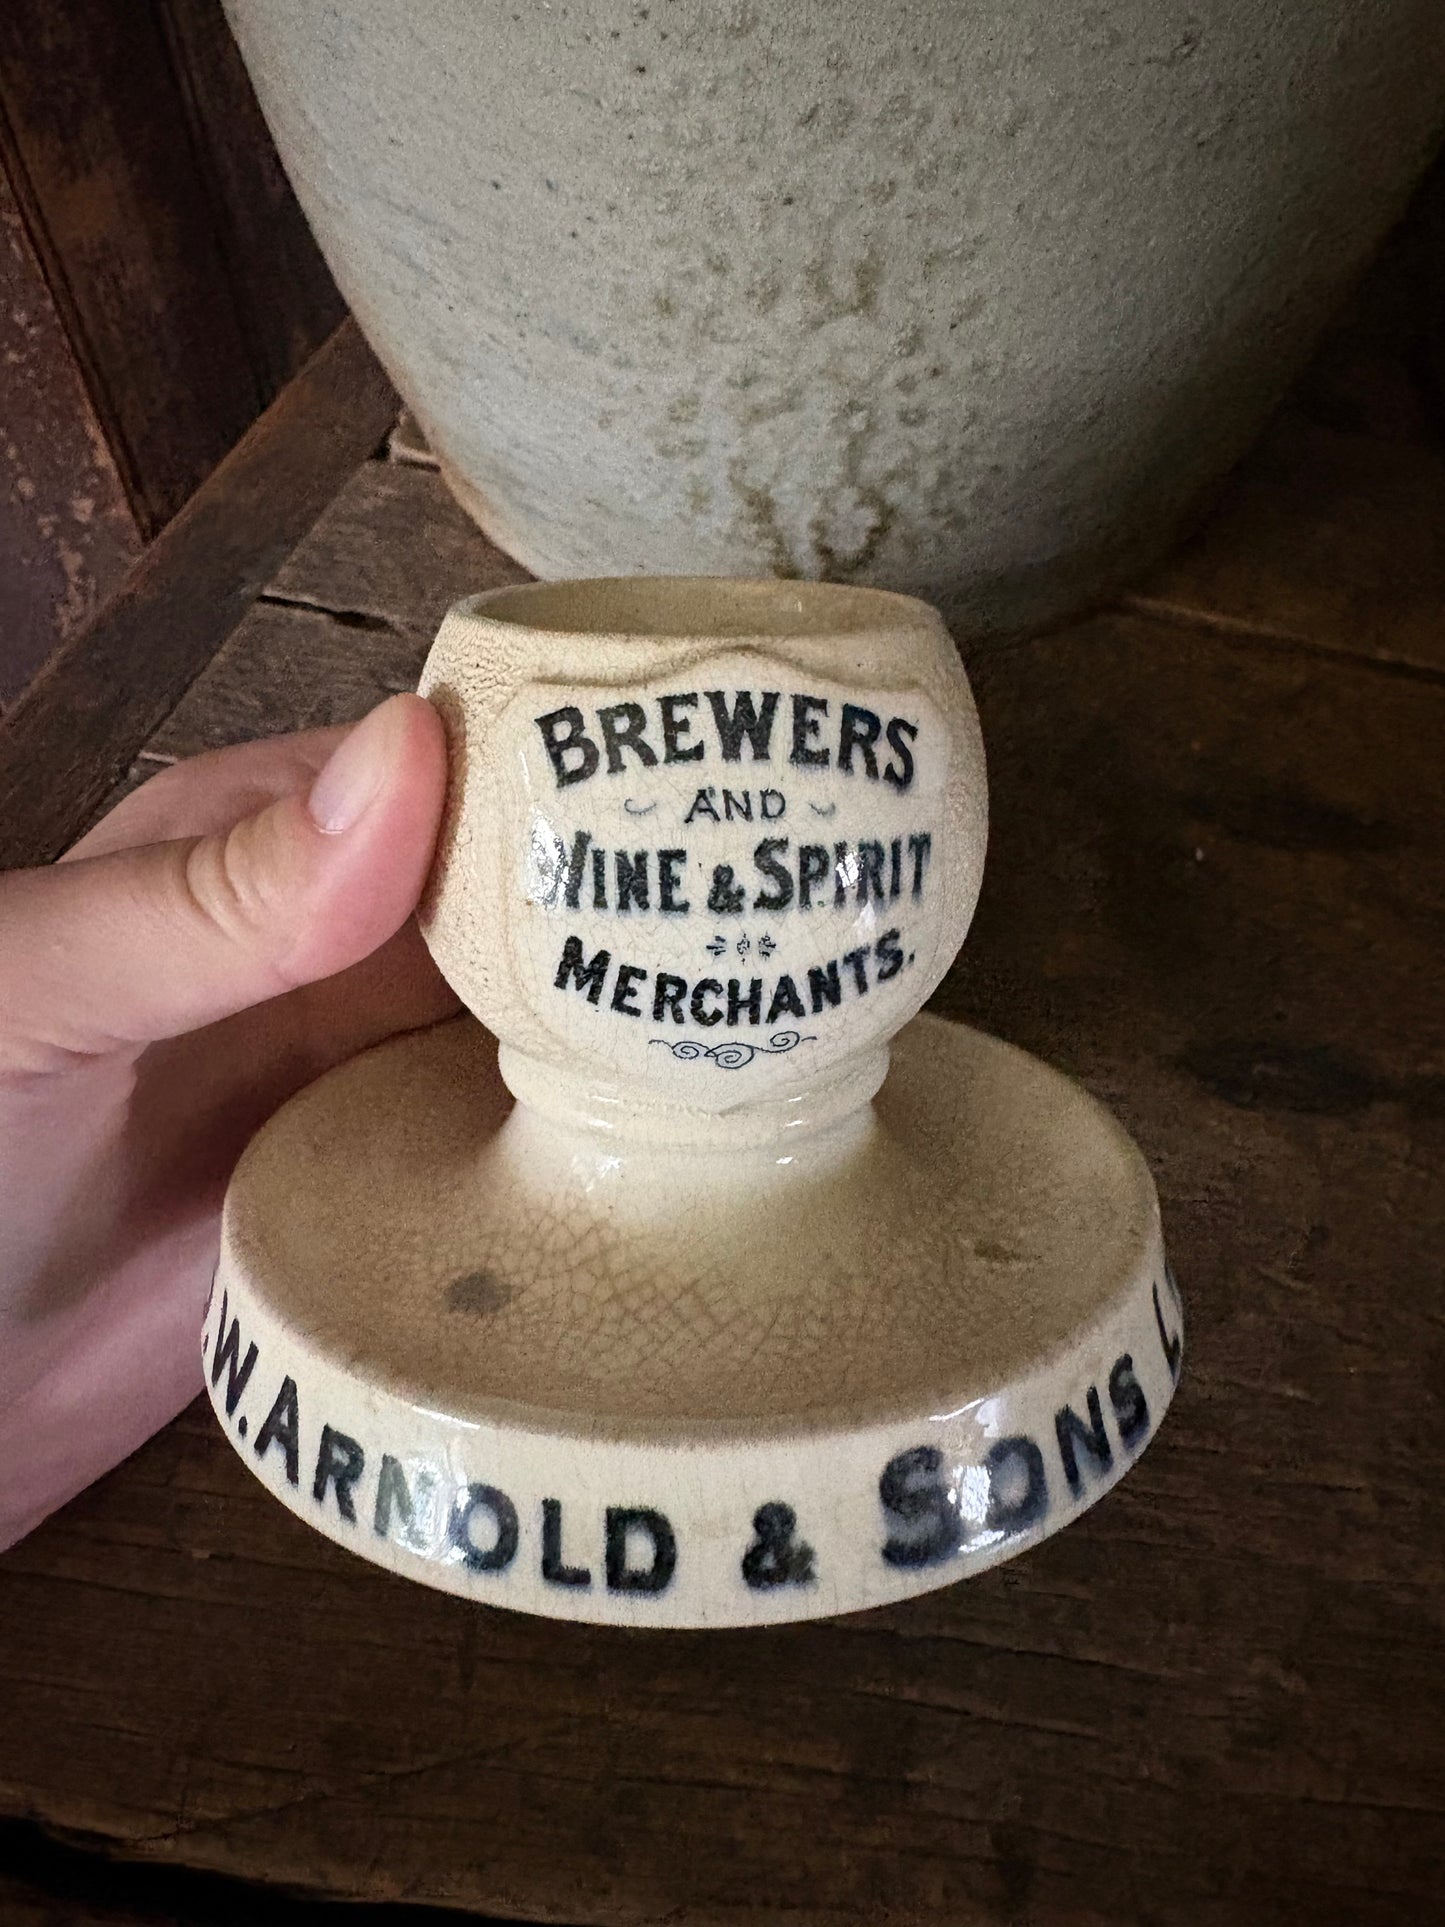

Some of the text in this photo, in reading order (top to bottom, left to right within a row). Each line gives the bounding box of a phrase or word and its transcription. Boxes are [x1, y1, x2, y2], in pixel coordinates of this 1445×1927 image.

[534, 691, 919, 793] BREWERS
[684, 787, 787, 824] AND
[707, 864, 745, 913] &
[753, 832, 932, 911] SPIRIT
[553, 929, 915, 1027] MERCHANTS.
[742, 1501, 816, 1591] &
[879, 1353, 1150, 1569] SONS
